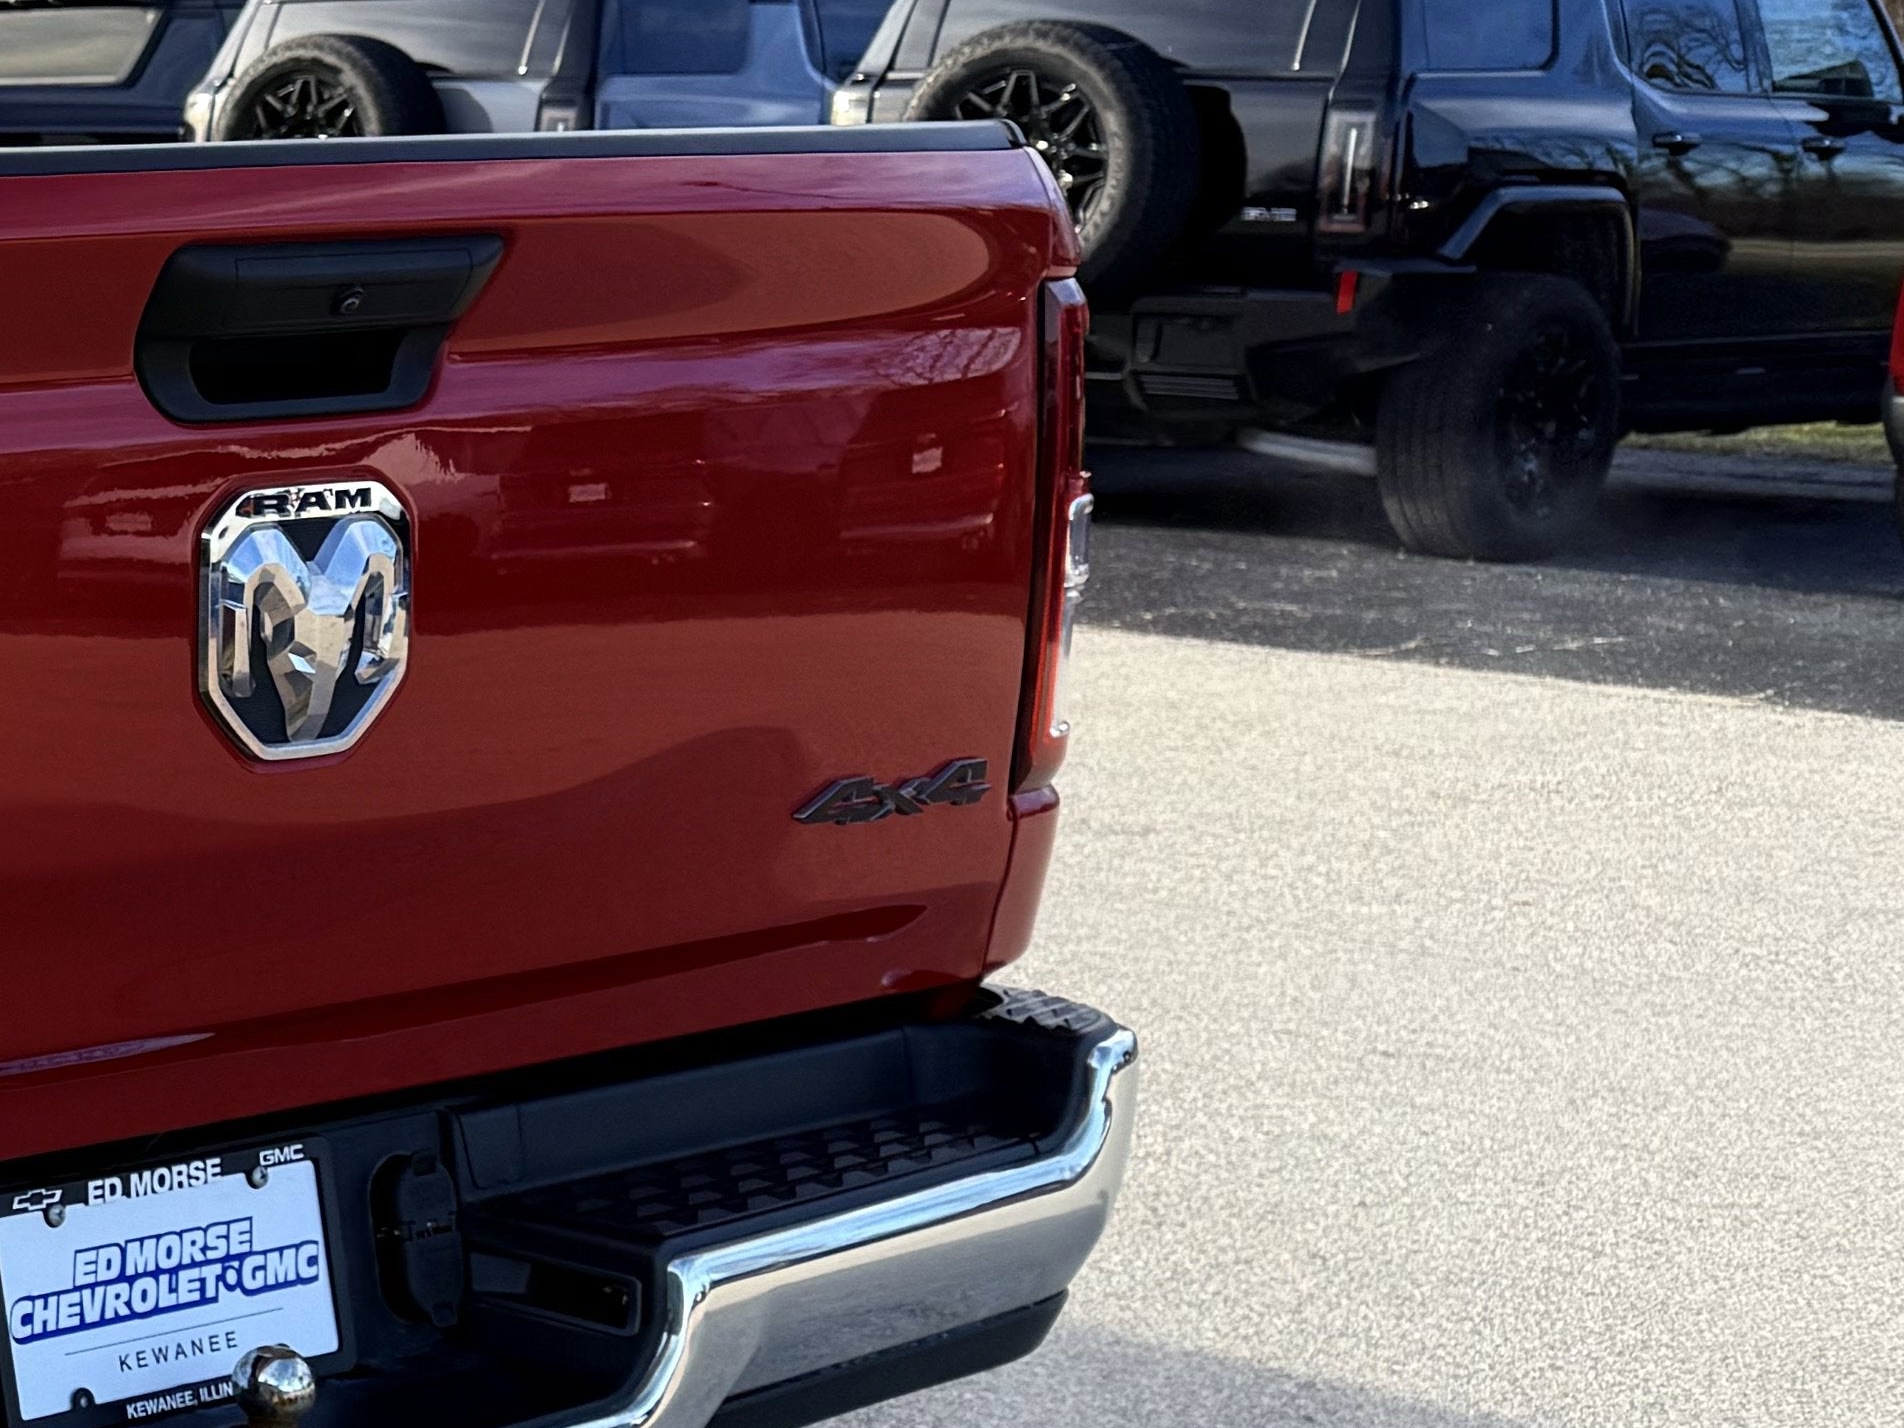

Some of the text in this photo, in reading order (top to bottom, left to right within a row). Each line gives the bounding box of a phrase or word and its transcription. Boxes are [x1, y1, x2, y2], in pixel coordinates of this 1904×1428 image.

[236, 486, 372, 518] RAM
[259, 1144, 305, 1166] GMC
[87, 1157, 222, 1206] ED MORSE
[73, 1216, 253, 1289] ED MORSE
[117, 1330, 239, 1373] KEWANEE
[126, 1380, 234, 1419] KEWANEE, ILLIN
